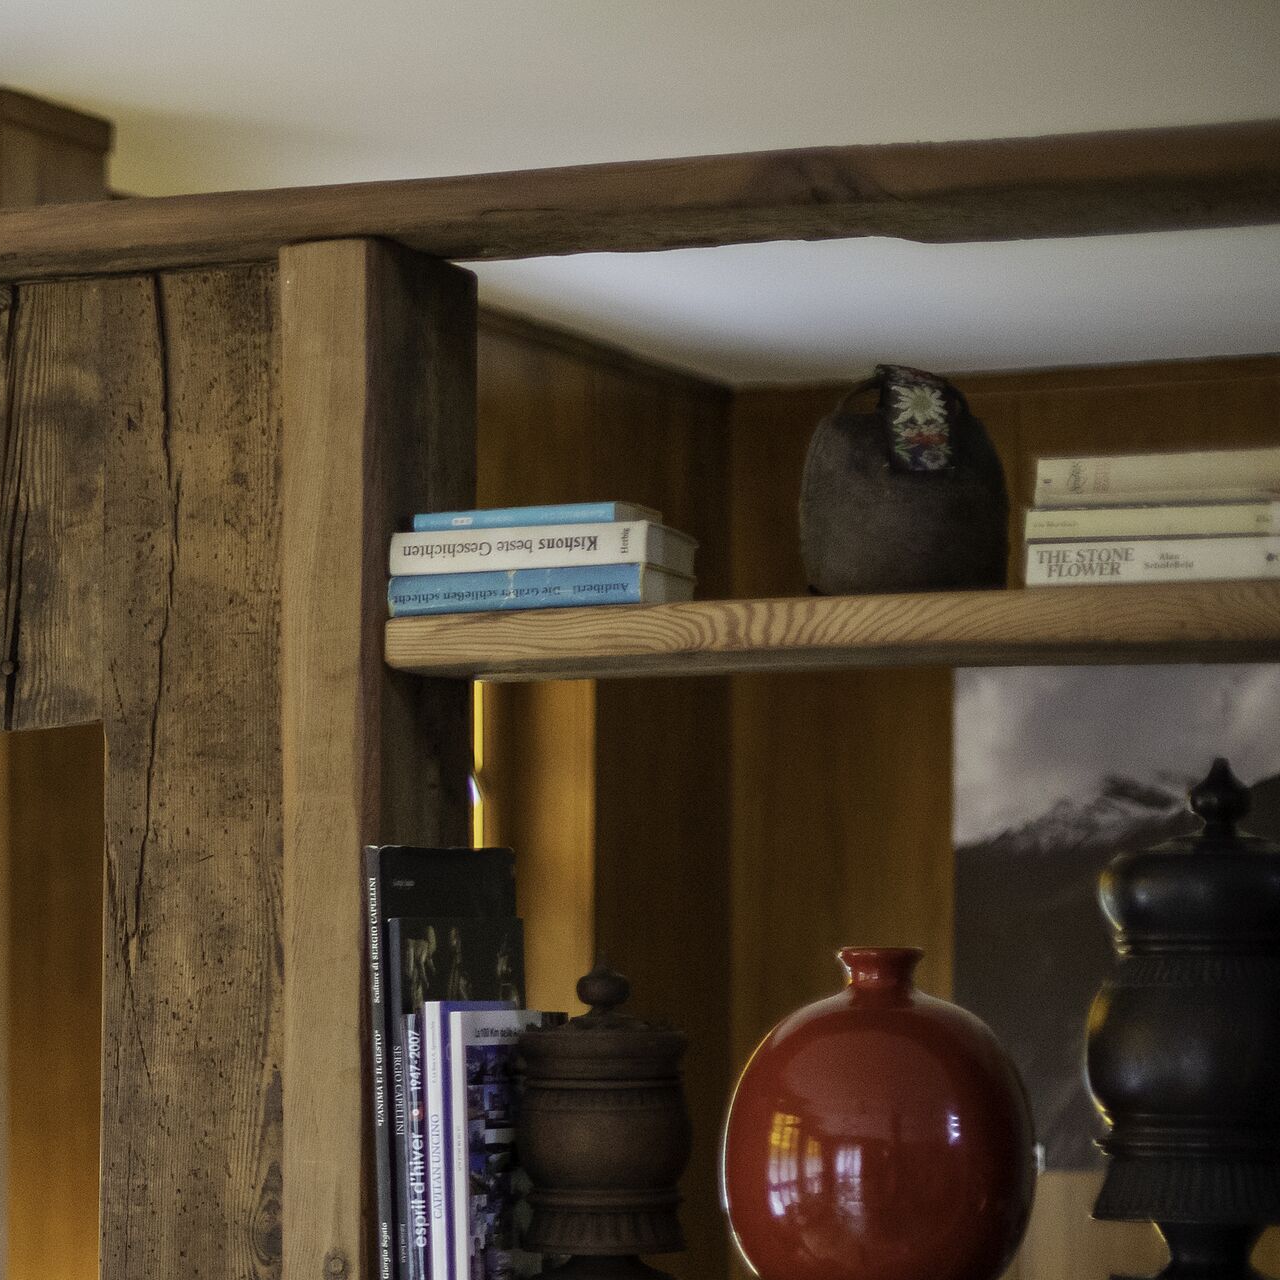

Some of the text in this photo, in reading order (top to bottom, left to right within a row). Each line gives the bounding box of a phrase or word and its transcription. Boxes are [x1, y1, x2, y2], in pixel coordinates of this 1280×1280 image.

[402, 535, 598, 560] Kishons beste Geschichten
[1037, 547, 1135, 565] THE STONE
[1047, 562, 1122, 578] FLOWER
[392, 592, 441, 606] schlecht
[443, 588, 498, 601] schließen
[368, 876, 378, 925] CAPELLINI
[371, 925, 379, 960] SERGIO
[409, 1029, 422, 1092] 1947-2007
[393, 1045, 405, 1136] SERGIO CAPELLINI
[429, 1113, 443, 1219] CAPITAN UNCINO
[409, 1131, 429, 1248] esprit d'hiver
[382, 1248, 392, 1280] Giorgio
